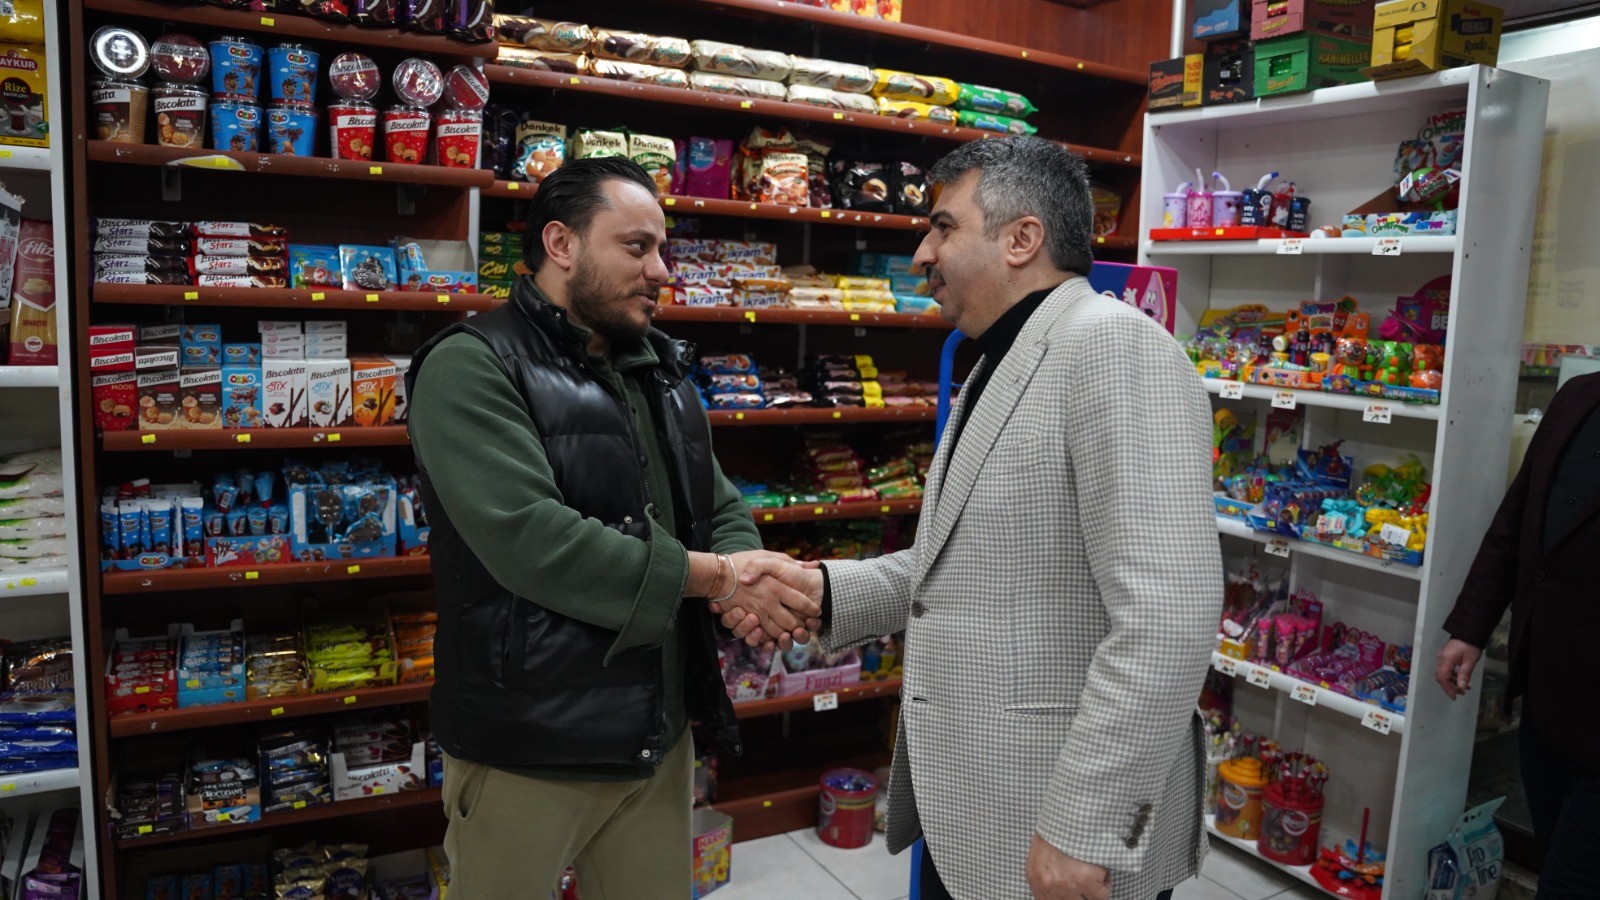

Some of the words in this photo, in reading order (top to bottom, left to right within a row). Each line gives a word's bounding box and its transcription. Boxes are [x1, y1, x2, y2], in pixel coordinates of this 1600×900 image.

[156, 98, 197, 111] Biscolata
[93, 332, 130, 345] Biscolata
[94, 354, 132, 366] Biscolata
[95, 372, 135, 385] Biscolata
[140, 372, 178, 385] Biscolata
[183, 373, 220, 385] Biscolata
[266, 367, 305, 379] Biscolata
[310, 367, 349, 380] Biscolata
[356, 367, 394, 380] Biscolata
[805, 672, 843, 690] Funzi
